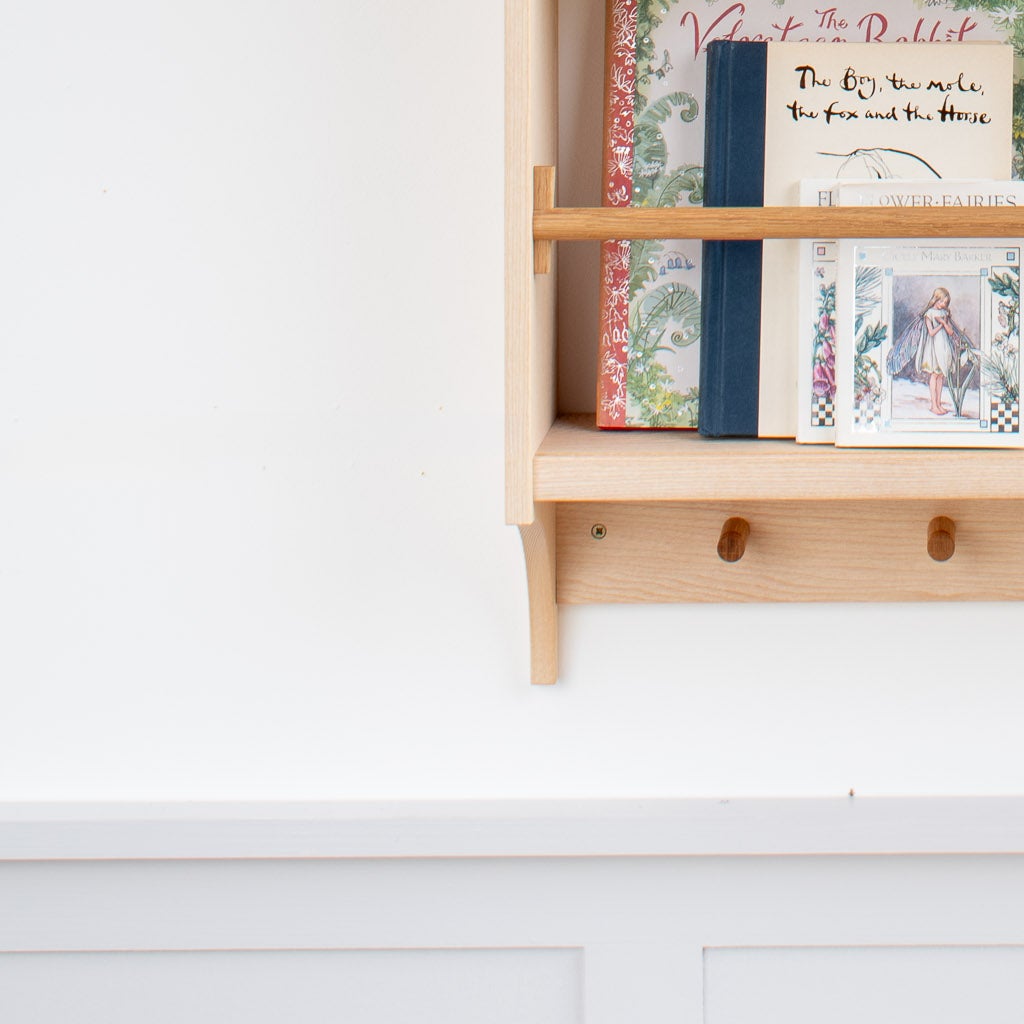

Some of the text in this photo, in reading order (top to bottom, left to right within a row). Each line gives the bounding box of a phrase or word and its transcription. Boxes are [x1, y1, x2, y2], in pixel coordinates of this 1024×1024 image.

[814, 7, 848, 30] The
[795, 65, 831, 89] The
[886, 73, 921, 90] the
[787, 94, 991, 124] the fox and the Horse
